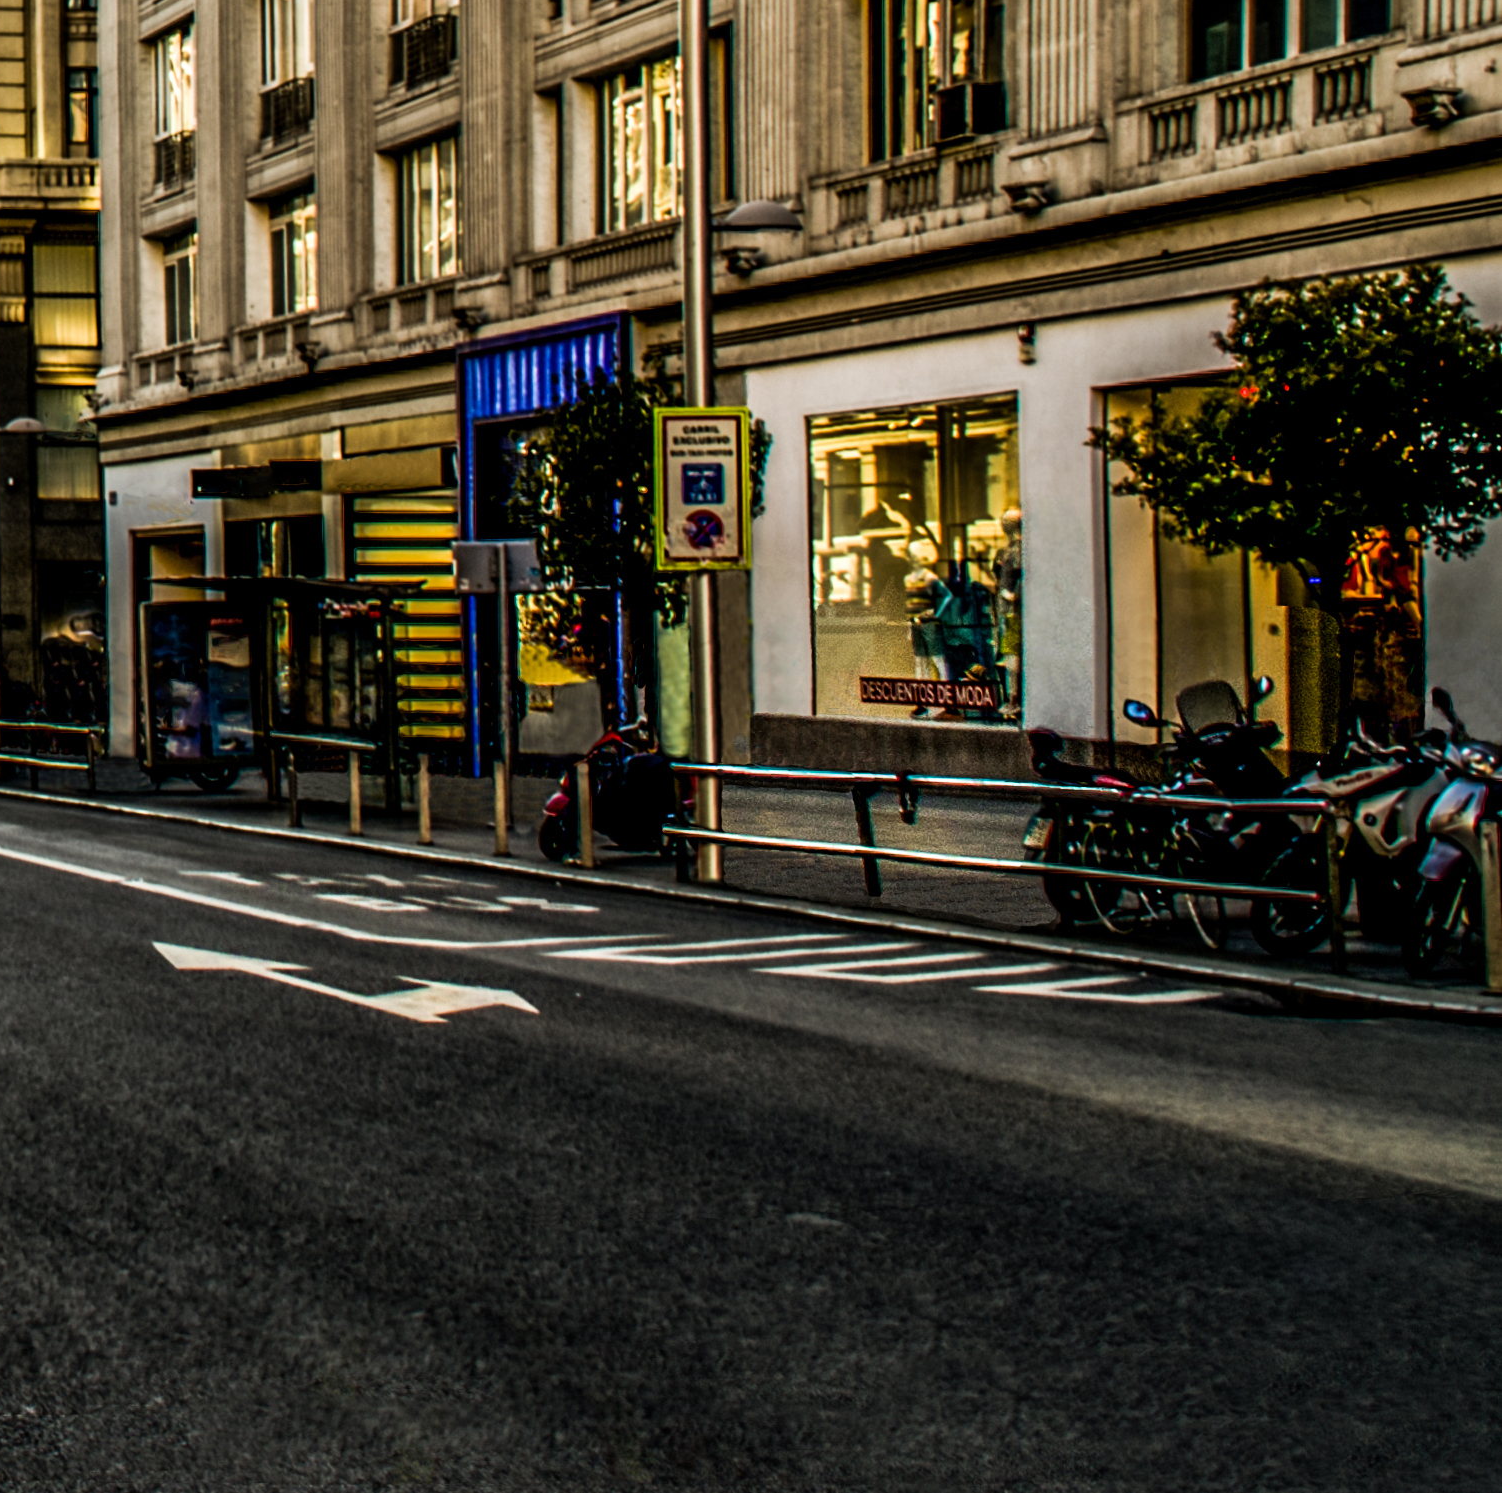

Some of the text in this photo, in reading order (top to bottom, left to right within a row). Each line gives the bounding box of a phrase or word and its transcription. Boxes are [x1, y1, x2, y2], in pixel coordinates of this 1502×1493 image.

[682, 425, 721, 435] CARRIL
[672, 435, 731, 445] EXCLUSIVO
[861, 680, 994, 707] DESCUENTOS DE MODA
[312, 893, 601, 912] BUS
